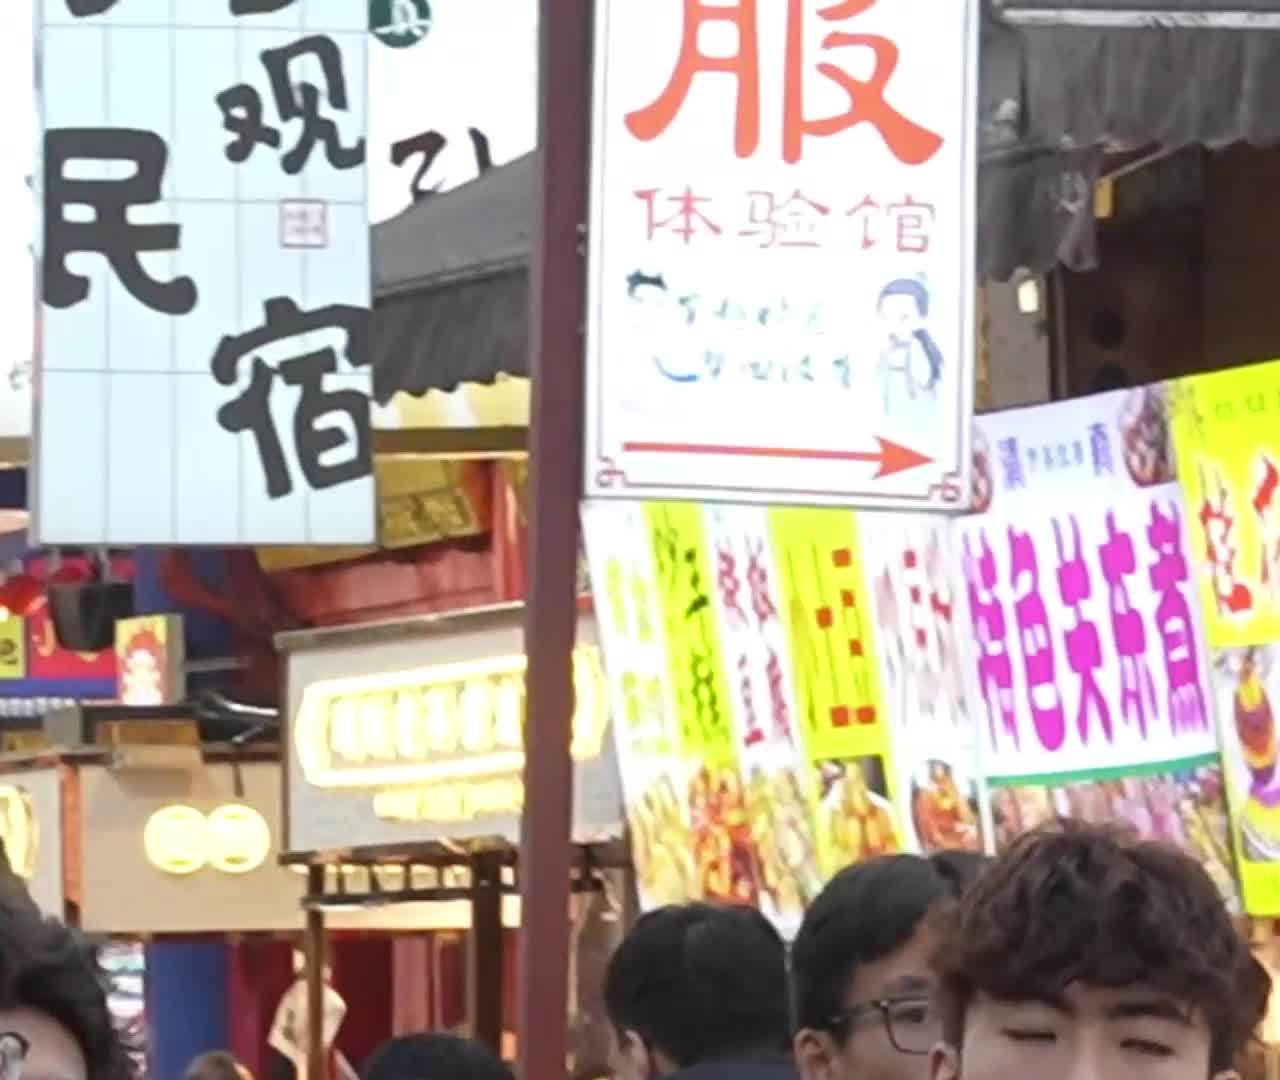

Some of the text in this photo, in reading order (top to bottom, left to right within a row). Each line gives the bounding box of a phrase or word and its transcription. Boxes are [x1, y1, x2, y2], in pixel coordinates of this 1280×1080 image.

[632, 186, 936, 254] 体验馆
[963, 499, 1208, 752] 特色关东煮
